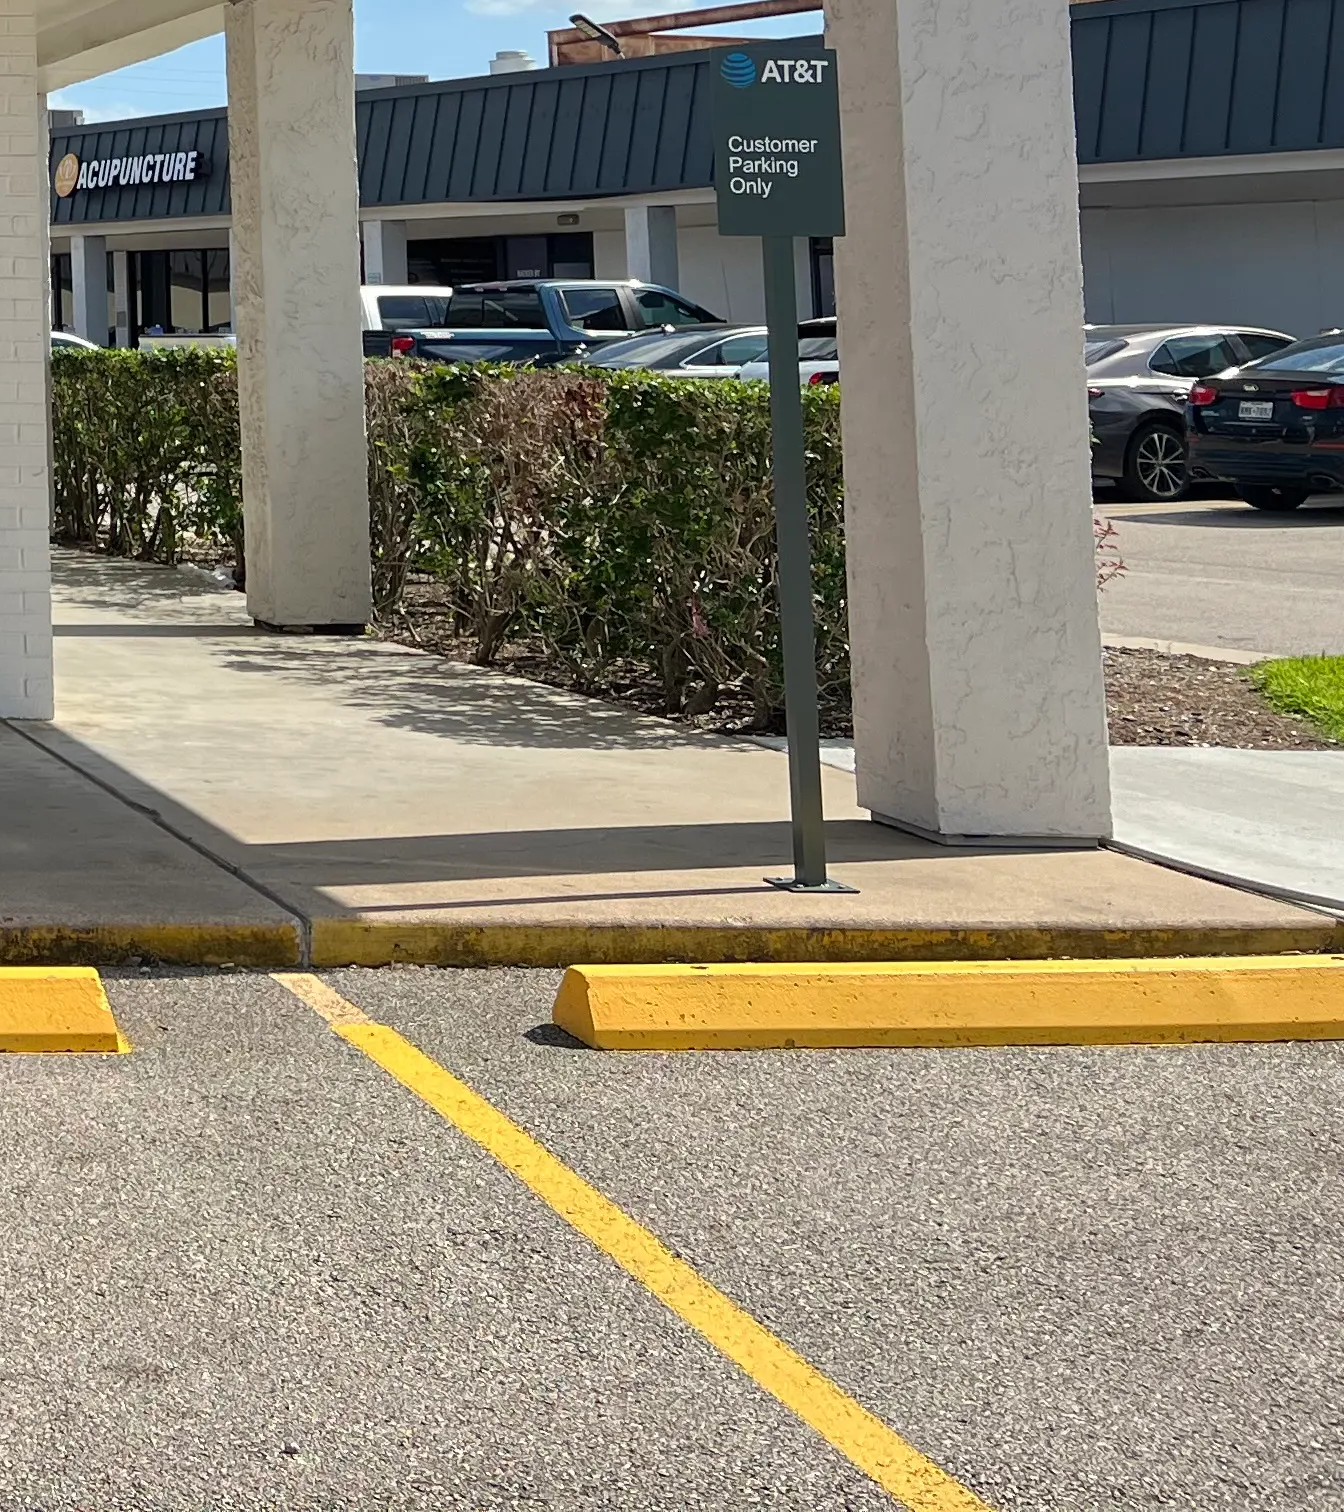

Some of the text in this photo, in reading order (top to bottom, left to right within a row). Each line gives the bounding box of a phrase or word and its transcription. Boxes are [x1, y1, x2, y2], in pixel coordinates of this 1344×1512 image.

[760, 59, 829, 83] AT&T
[728, 135, 818, 153] Customer
[76, 150, 198, 190] ACUPUNCTURE
[728, 156, 799, 178] Parking
[730, 177, 773, 199] Only
